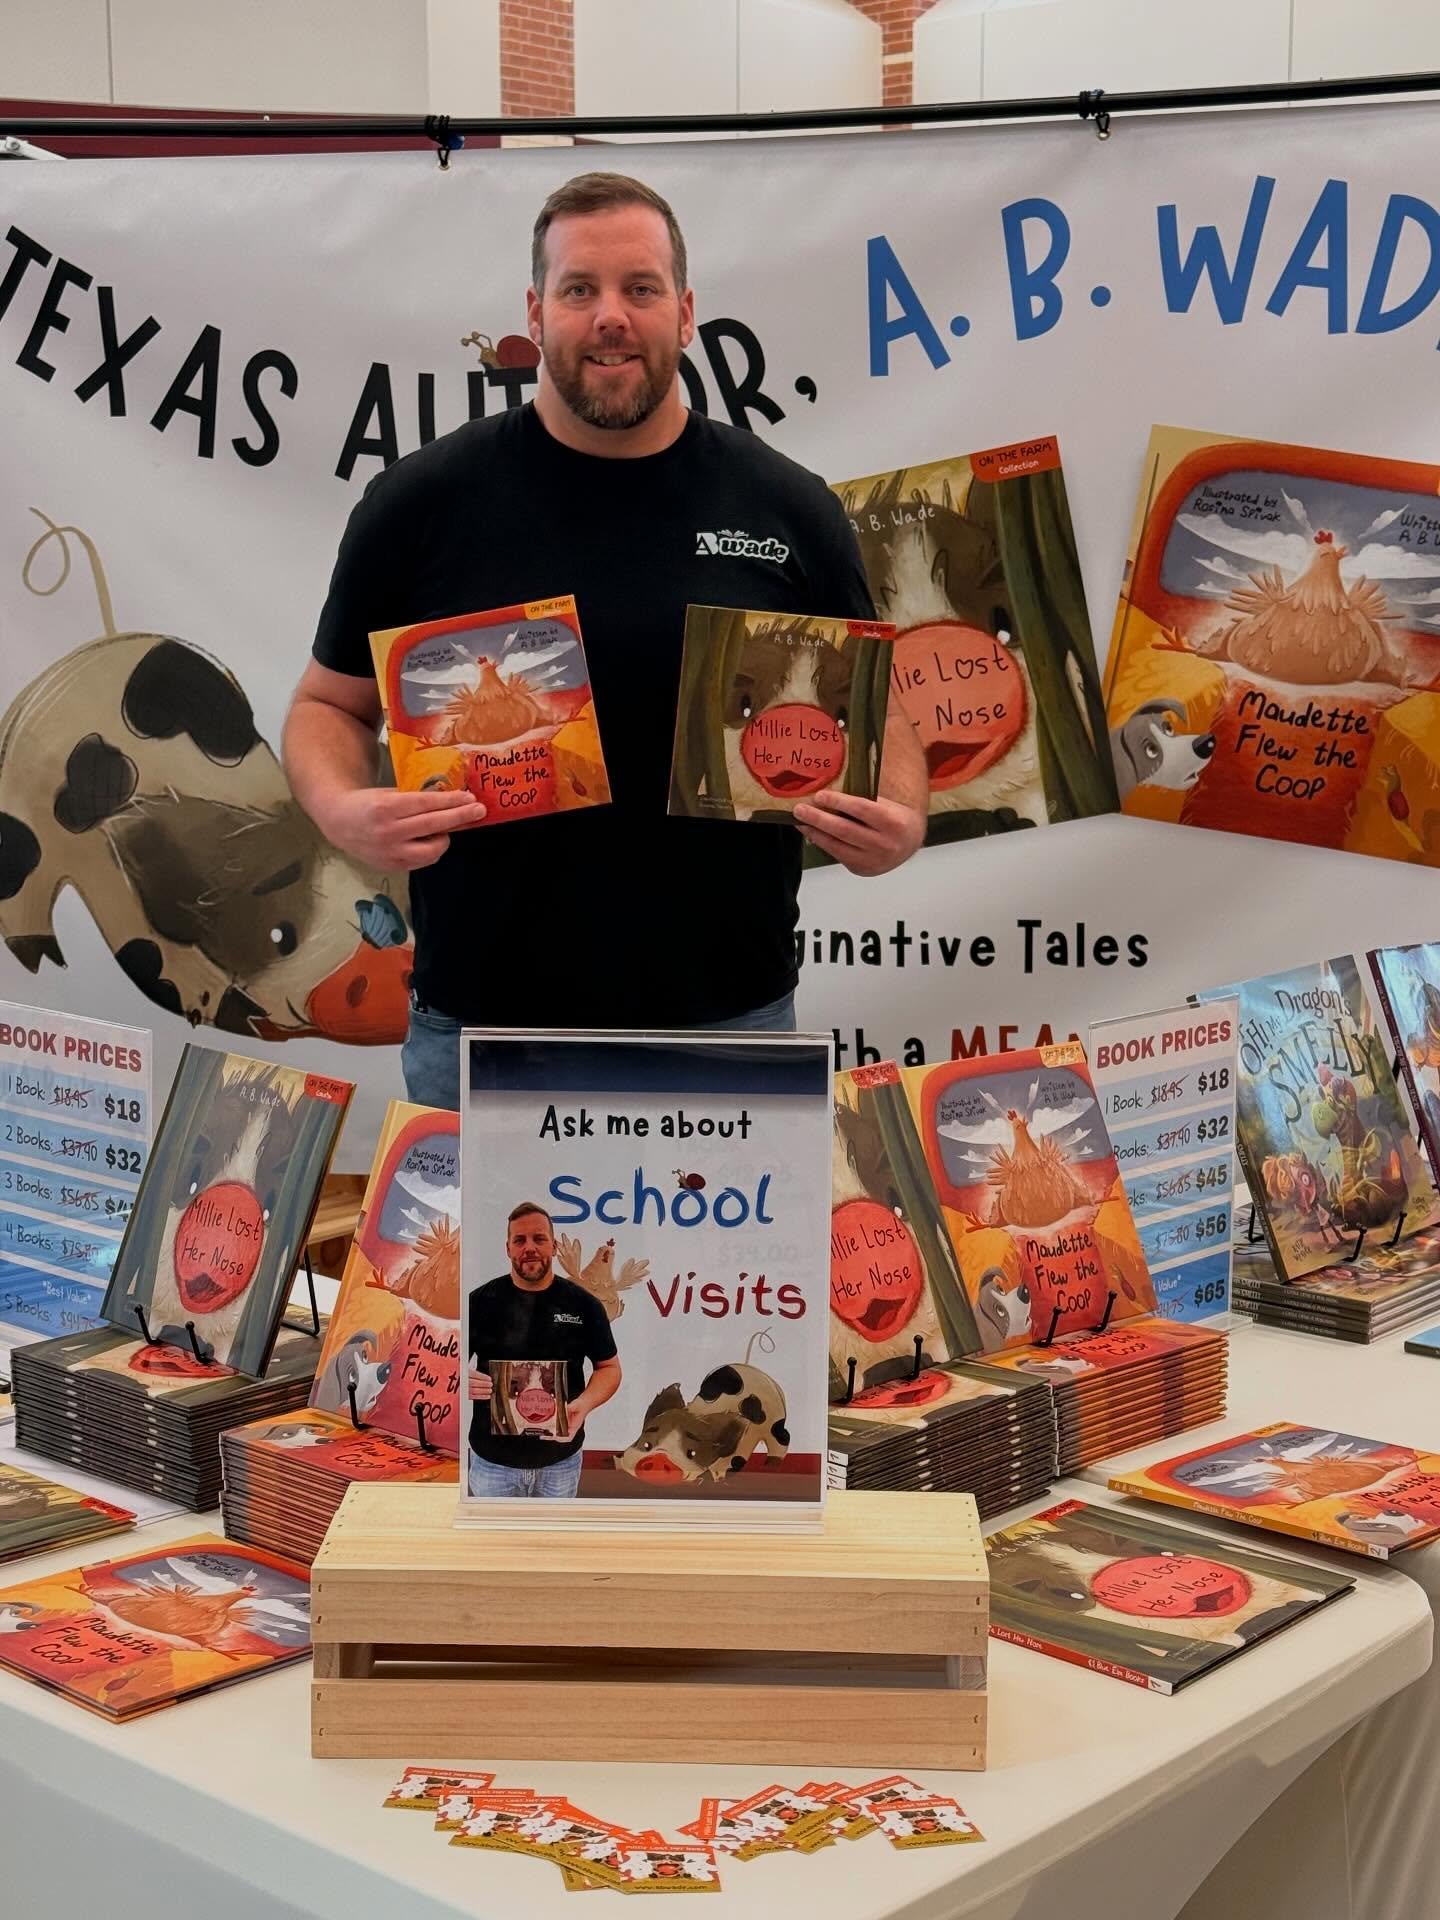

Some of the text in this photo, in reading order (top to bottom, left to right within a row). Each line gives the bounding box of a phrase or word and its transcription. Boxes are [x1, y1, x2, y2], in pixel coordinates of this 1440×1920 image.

[0, 225, 298, 467] TEXAS
[867, 235, 970, 377] A.
[1001, 197, 1111, 341] B.
[1157, 175, 1440, 351] WAD
[979, 442, 1052, 467] ON THE FARM
[998, 458, 1039, 474] Collection
[1202, 486, 1279, 508] Illustrated by
[869, 514, 886, 532] B.
[891, 505, 936, 527] Wade
[719, 537, 789, 563] wade
[800, 635, 826, 648] Wade
[934, 643, 1009, 682] Lost
[935, 698, 1007, 731] Nose
[1238, 690, 1370, 735] Maudette
[750, 720, 840, 742] Millie Lost
[1234, 724, 1357, 768] Flew the
[475, 744, 549, 772] Maudette
[754, 748, 832, 769] Her Nose
[480, 765, 550, 791] Flew the
[1017, 919, 1150, 974] Tales
[1274, 986, 1352, 1019] Dragon's
[0, 1023, 142, 1073] BOOK PRICES
[903, 1036, 926, 1068] a
[1097, 1020, 1232, 1069] BOOK PRICES
[1198, 1068, 1229, 1096] $18
[1268, 1018, 1380, 1123] SMELLY
[16, 1076, 46, 1100] Book:
[104, 1093, 141, 1123] $18
[539, 1104, 752, 1142] Ask me about
[1197, 1115, 1229, 1144] $32
[5, 1124, 12, 1142] 2
[16, 1126, 54, 1152] Books:
[105, 1144, 142, 1174] $32
[5, 1172, 12, 1188] 3
[16, 1174, 52, 1200] Books:
[1196, 1164, 1228, 1192] $45
[549, 1165, 774, 1227] School
[188, 1200, 262, 1241] Millie Lost
[860, 1218, 906, 1248] Lost
[1195, 1213, 1227, 1242] $56
[6, 1223, 54, 1252] 4 Books:
[1026, 1232, 1093, 1262] Maudette
[183, 1237, 245, 1275] Her Nose
[832, 1262, 912, 1304] Her Nose
[1034, 1258, 1098, 1290] Flew the
[5, 1294, 52, 1322] 5 Books:
[647, 1270, 807, 1320] Visits
[1194, 1278, 1225, 1308] $65
[401, 1354, 439, 1388] Flew
[1094, 1556, 1192, 1604] Millie Lost
[1138, 1572, 1224, 1613] Her Nose
[44, 1626, 125, 1664] Flew the
[75, 1616, 159, 1656] Maudette
